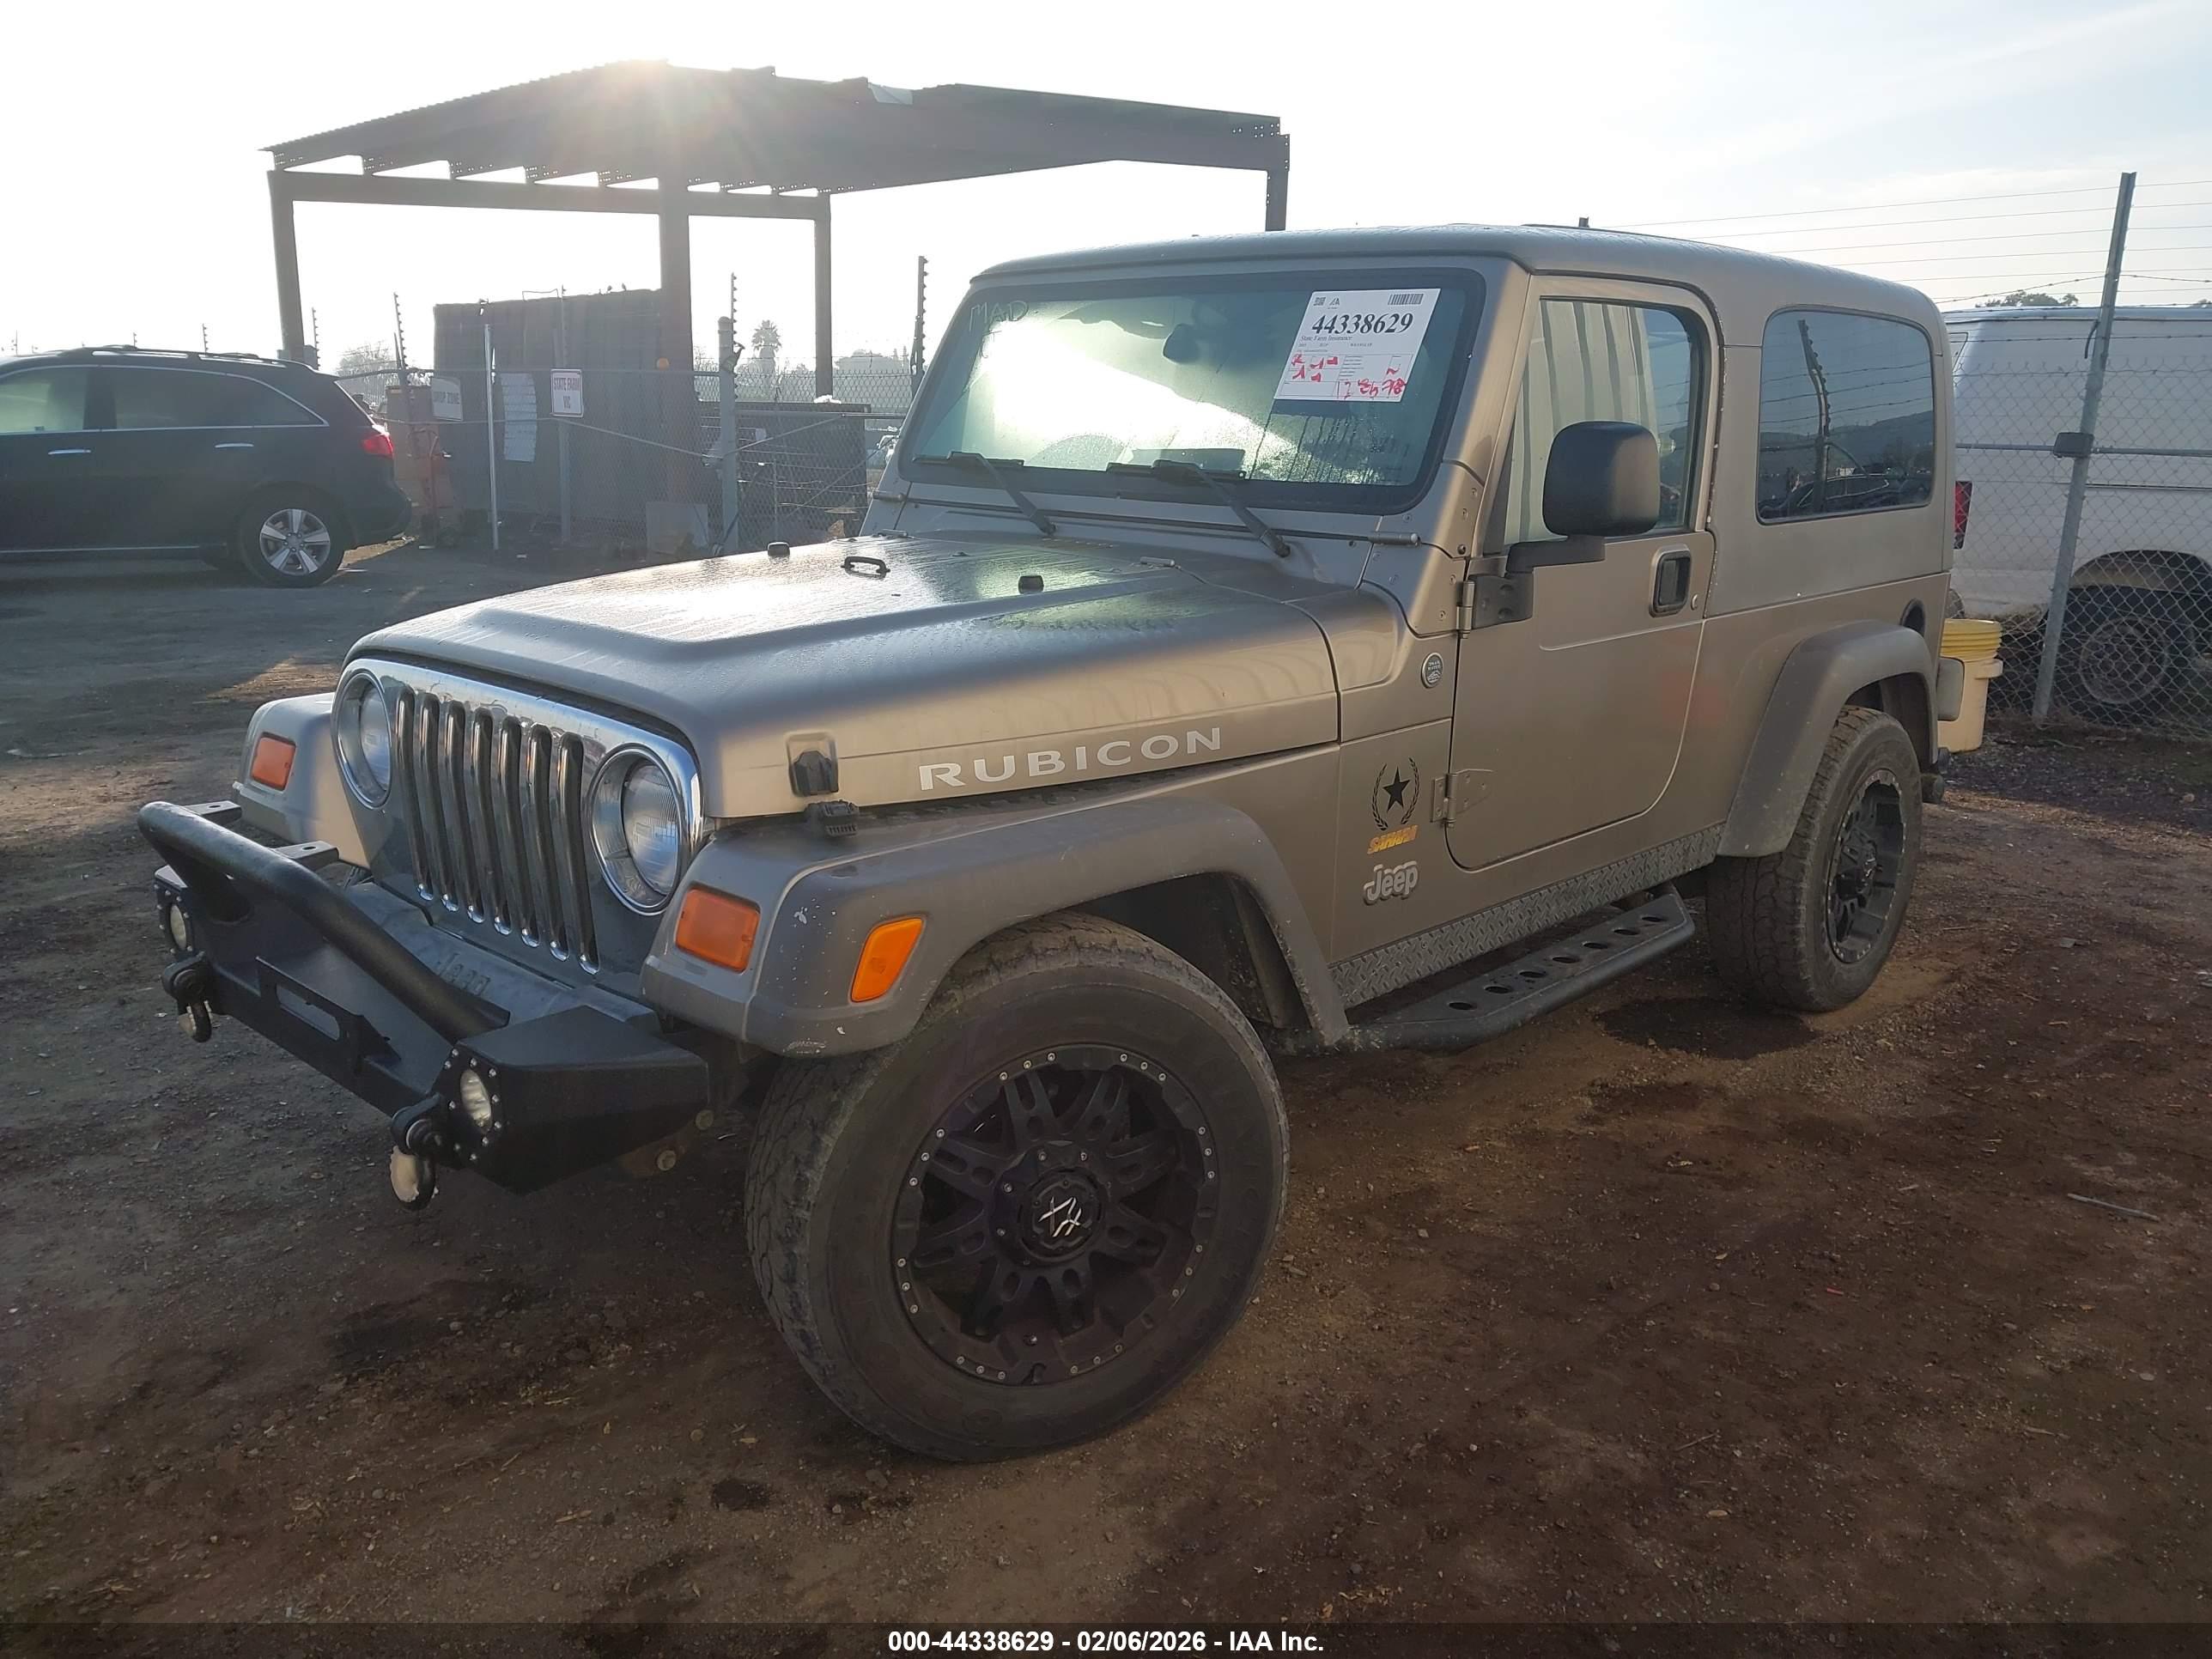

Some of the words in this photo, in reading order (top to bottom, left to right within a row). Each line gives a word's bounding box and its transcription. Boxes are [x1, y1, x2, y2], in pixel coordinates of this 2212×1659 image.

[1312, 313, 1413, 334] 44338629
[919, 728, 1220, 790] RUBICON
[1364, 860, 1418, 903] Jeep
